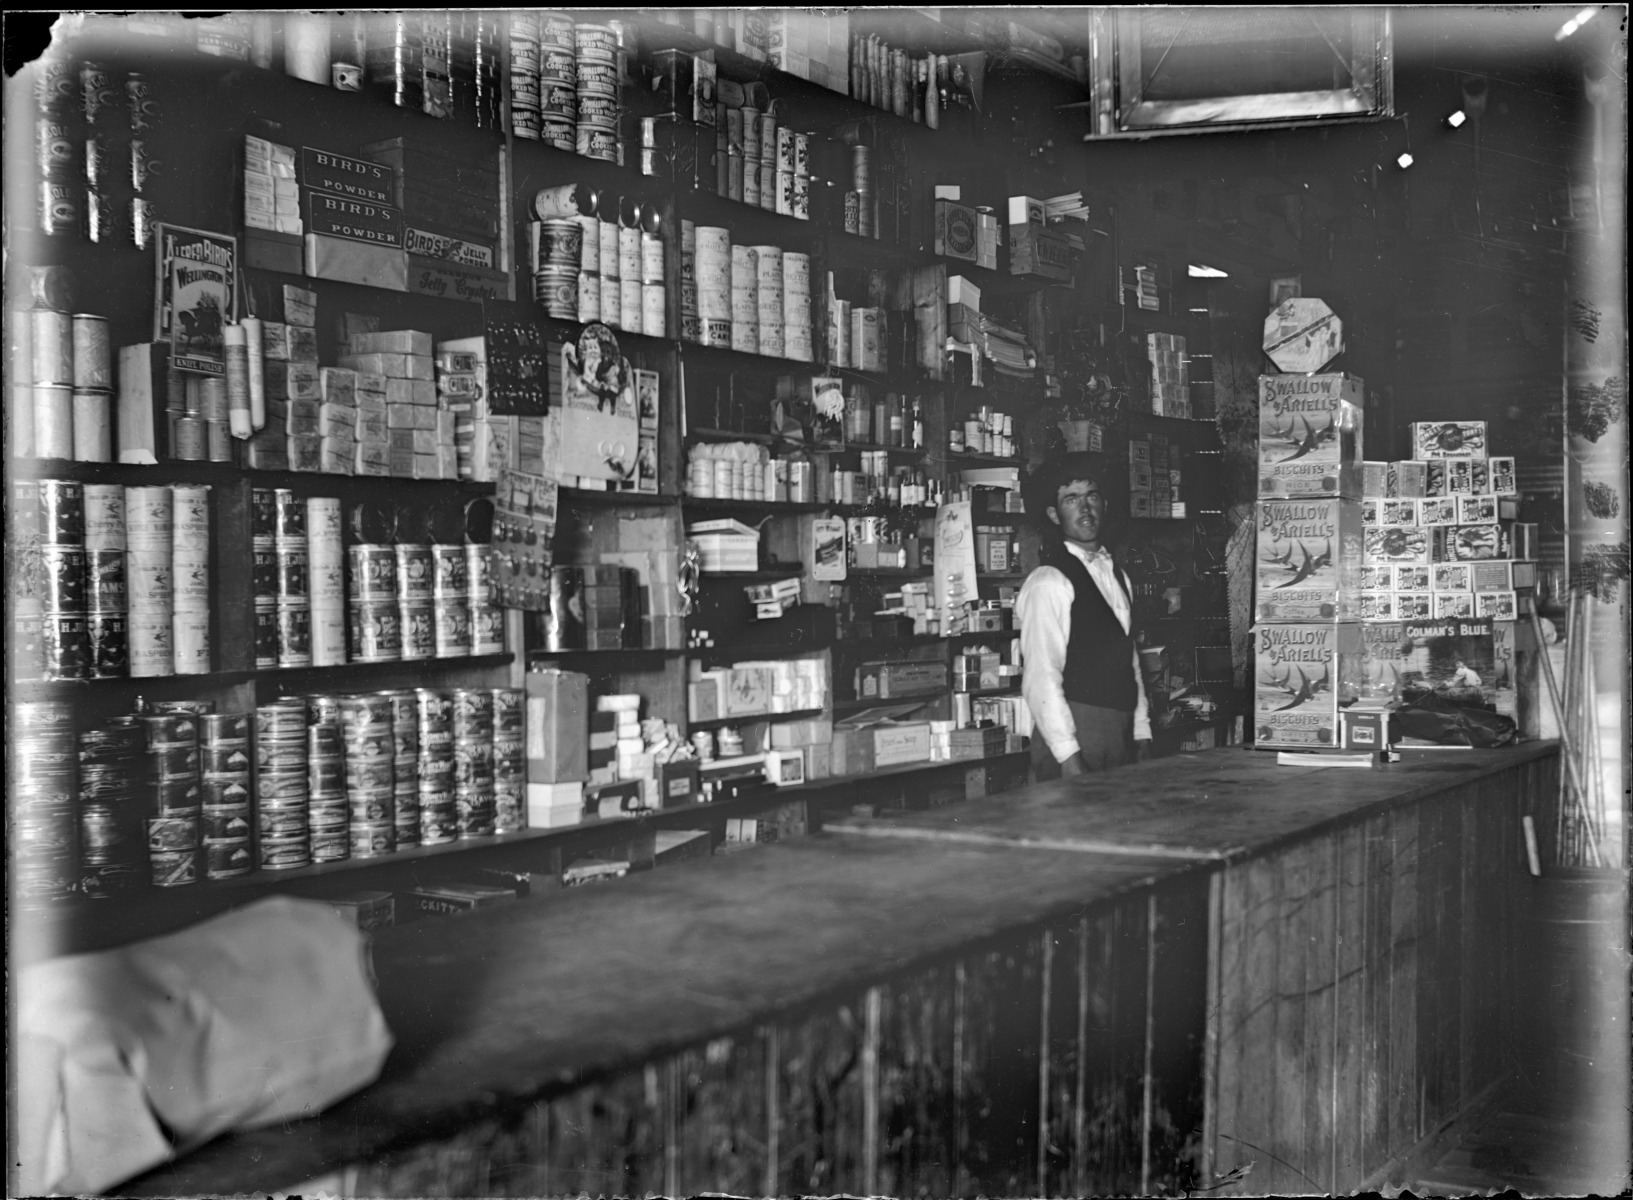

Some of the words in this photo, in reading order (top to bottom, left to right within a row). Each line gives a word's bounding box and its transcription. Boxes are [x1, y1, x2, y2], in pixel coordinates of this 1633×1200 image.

[316, 153, 382, 179] BIRD'S
[323, 179, 387, 202] POWDER
[324, 198, 391, 221] BIRD'S
[331, 223, 396, 244] POWDER
[405, 229, 441, 251] BIRD'S
[459, 256, 490, 268] POWDER
[463, 248, 487, 261] JELLY
[176, 266, 224, 290] WELLINGTON
[1262, 379, 1333, 405] SWALLOW
[1275, 398, 1338, 417] ARIELL'S
[1274, 464, 1325, 476] BISCUITS
[1261, 503, 1329, 531] SWALLOW
[1272, 521, 1334, 542] ARIELL'S
[1271, 591, 1322, 601] BISCUITS
[1258, 627, 1328, 654] SWALLOW
[1363, 627, 1401, 643] WALL
[1406, 625, 1455, 638] COLMAN'S
[1271, 644, 1333, 665] ARIELL'S
[1270, 714, 1320, 725] BISCUITS
